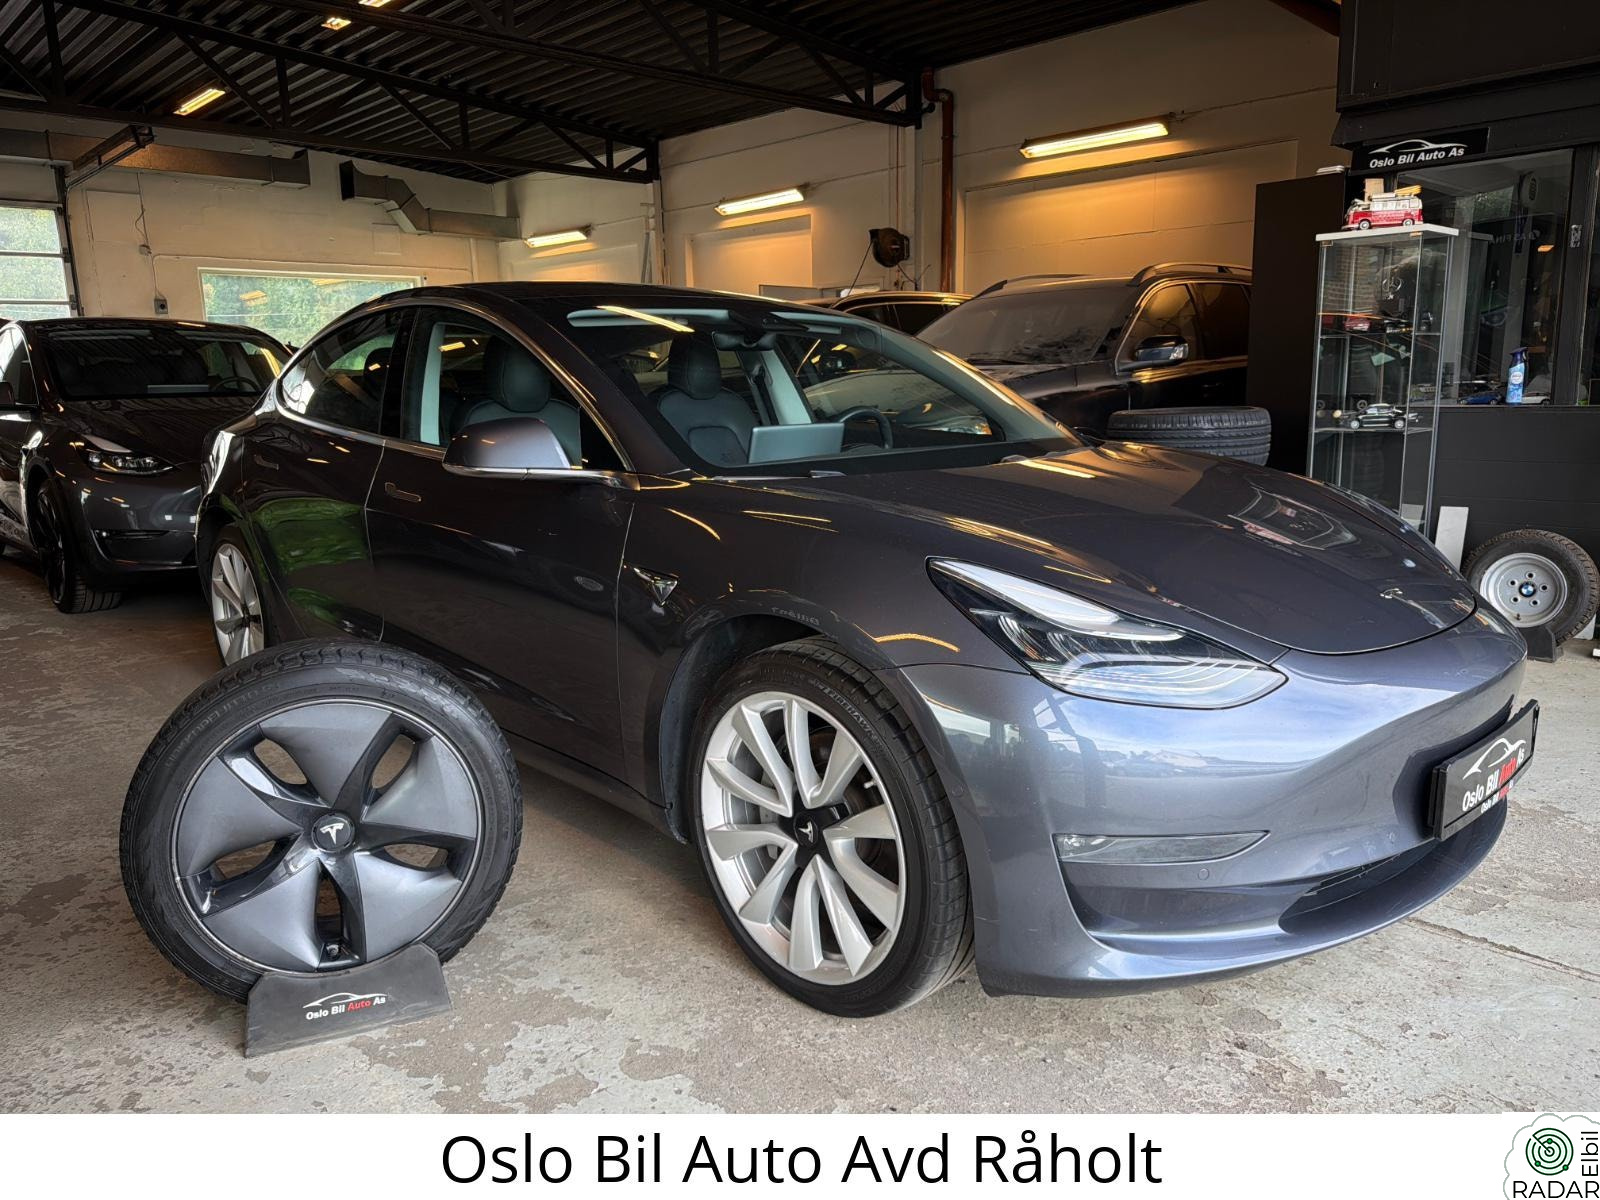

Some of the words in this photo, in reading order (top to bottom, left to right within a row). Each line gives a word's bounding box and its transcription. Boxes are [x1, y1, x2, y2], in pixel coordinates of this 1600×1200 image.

[1369, 157, 1394, 168] Oslo
[1397, 153, 1414, 164] Bil
[1416, 150, 1445, 161] Auto
[1447, 147, 1465, 157] As
[1463, 784, 1484, 812] Oslo
[1485, 769, 1499, 796] Bil
[306, 1009, 329, 1020] Oslo
[331, 1004, 346, 1015] Bil
[347, 1000, 371, 1011] Auto
[373, 996, 386, 1006] As
